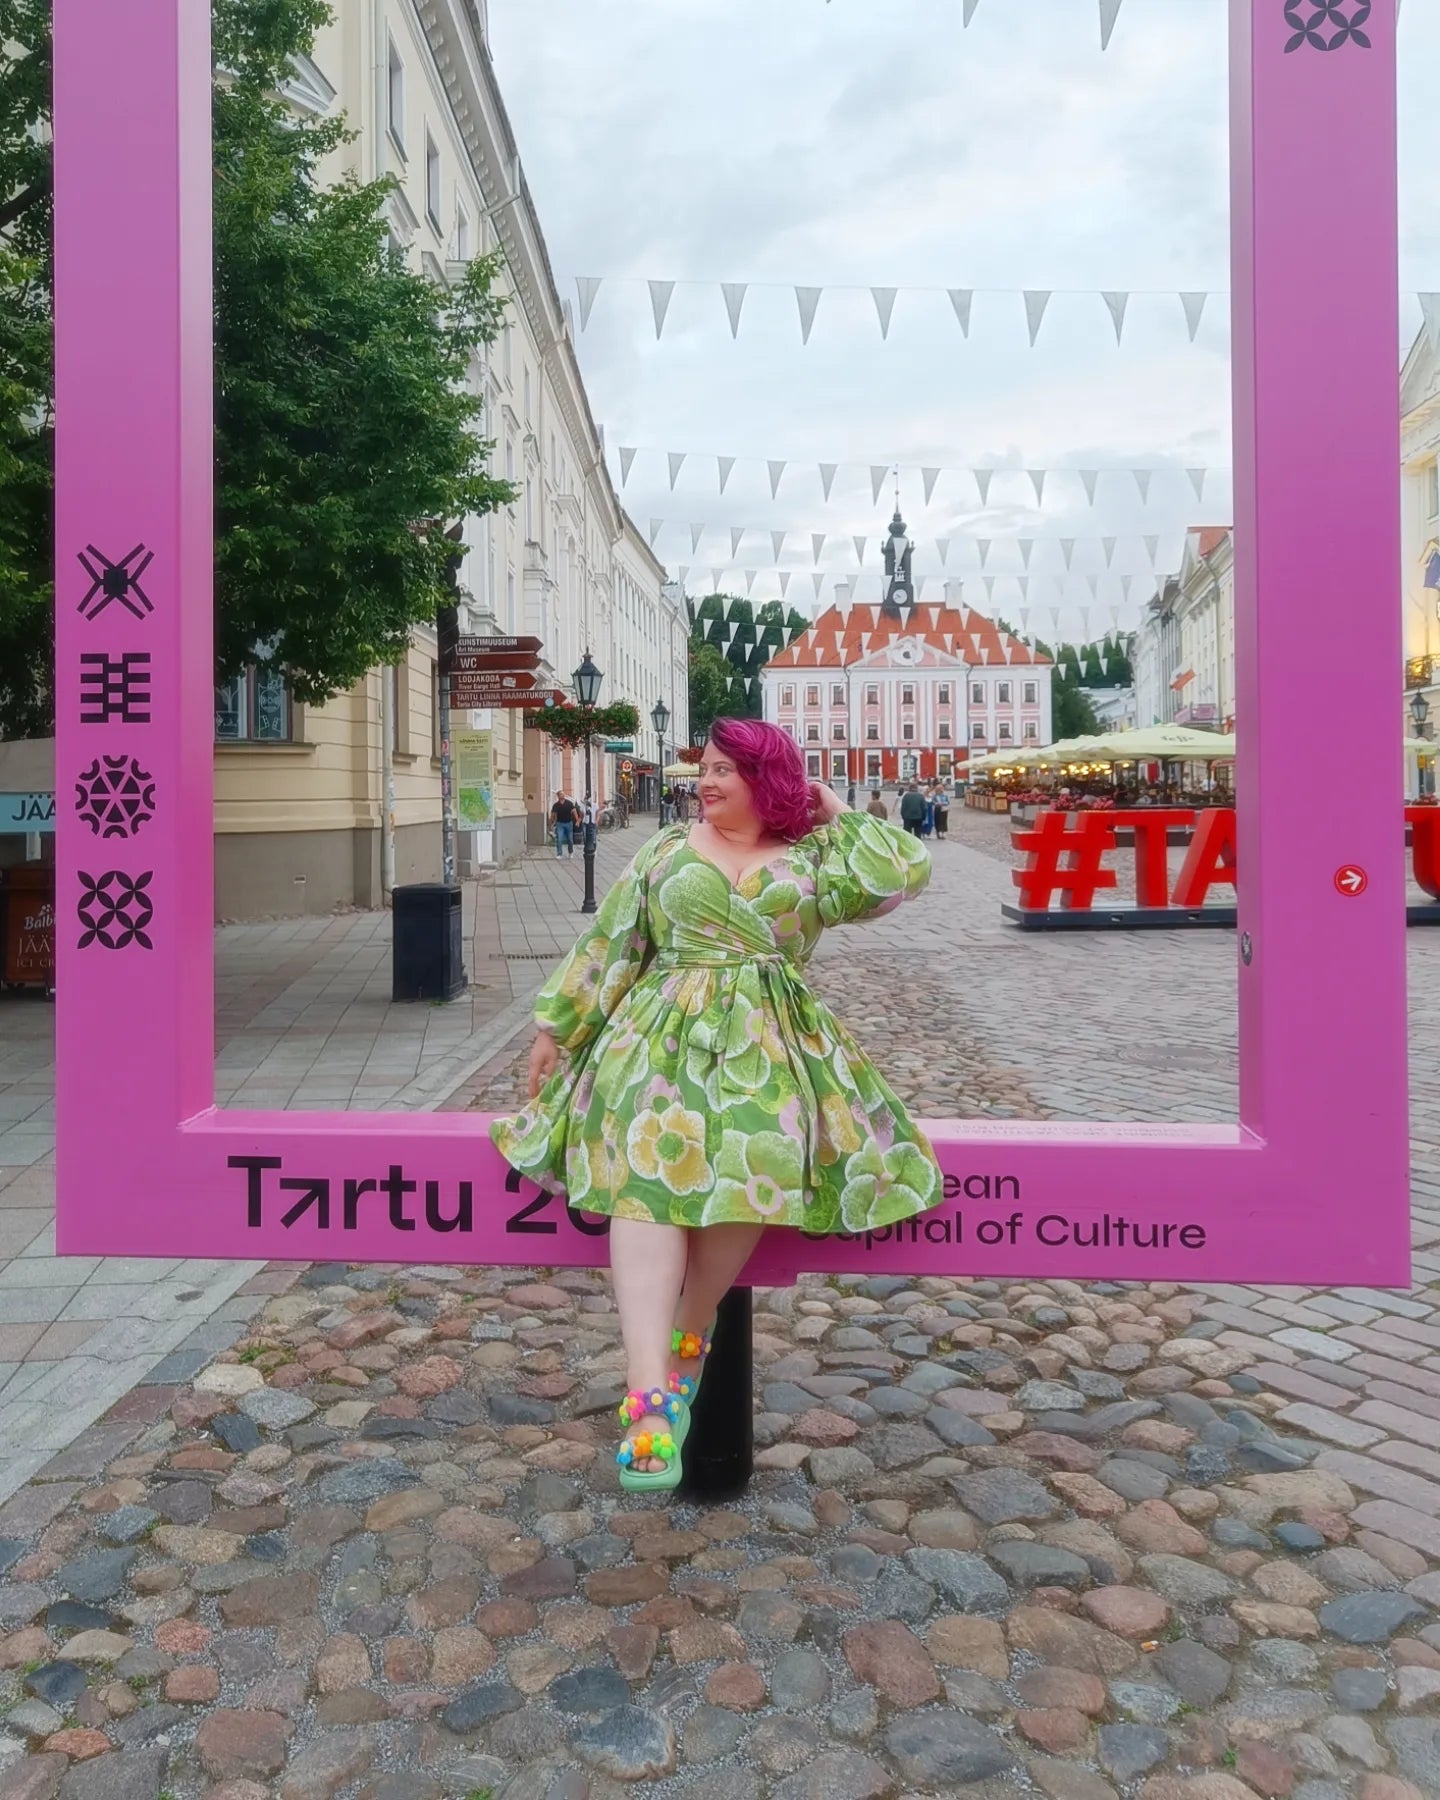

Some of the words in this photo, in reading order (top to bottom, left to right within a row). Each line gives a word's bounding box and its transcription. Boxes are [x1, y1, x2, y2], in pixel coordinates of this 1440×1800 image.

[458, 638, 518, 646] KUNSTIMUUSEUM
[460, 657, 478, 669] WC
[458, 675, 500, 683] LODJAKODA
[456, 693, 478, 701] TARTU
[502, 691, 554, 700] RAAMATUKOGU
[482, 701, 502, 709] Library
[18, 934, 54, 956] JÄÄ
[976, 1212, 1024, 1246] of
[1035, 1213, 1207, 1249] Culture
